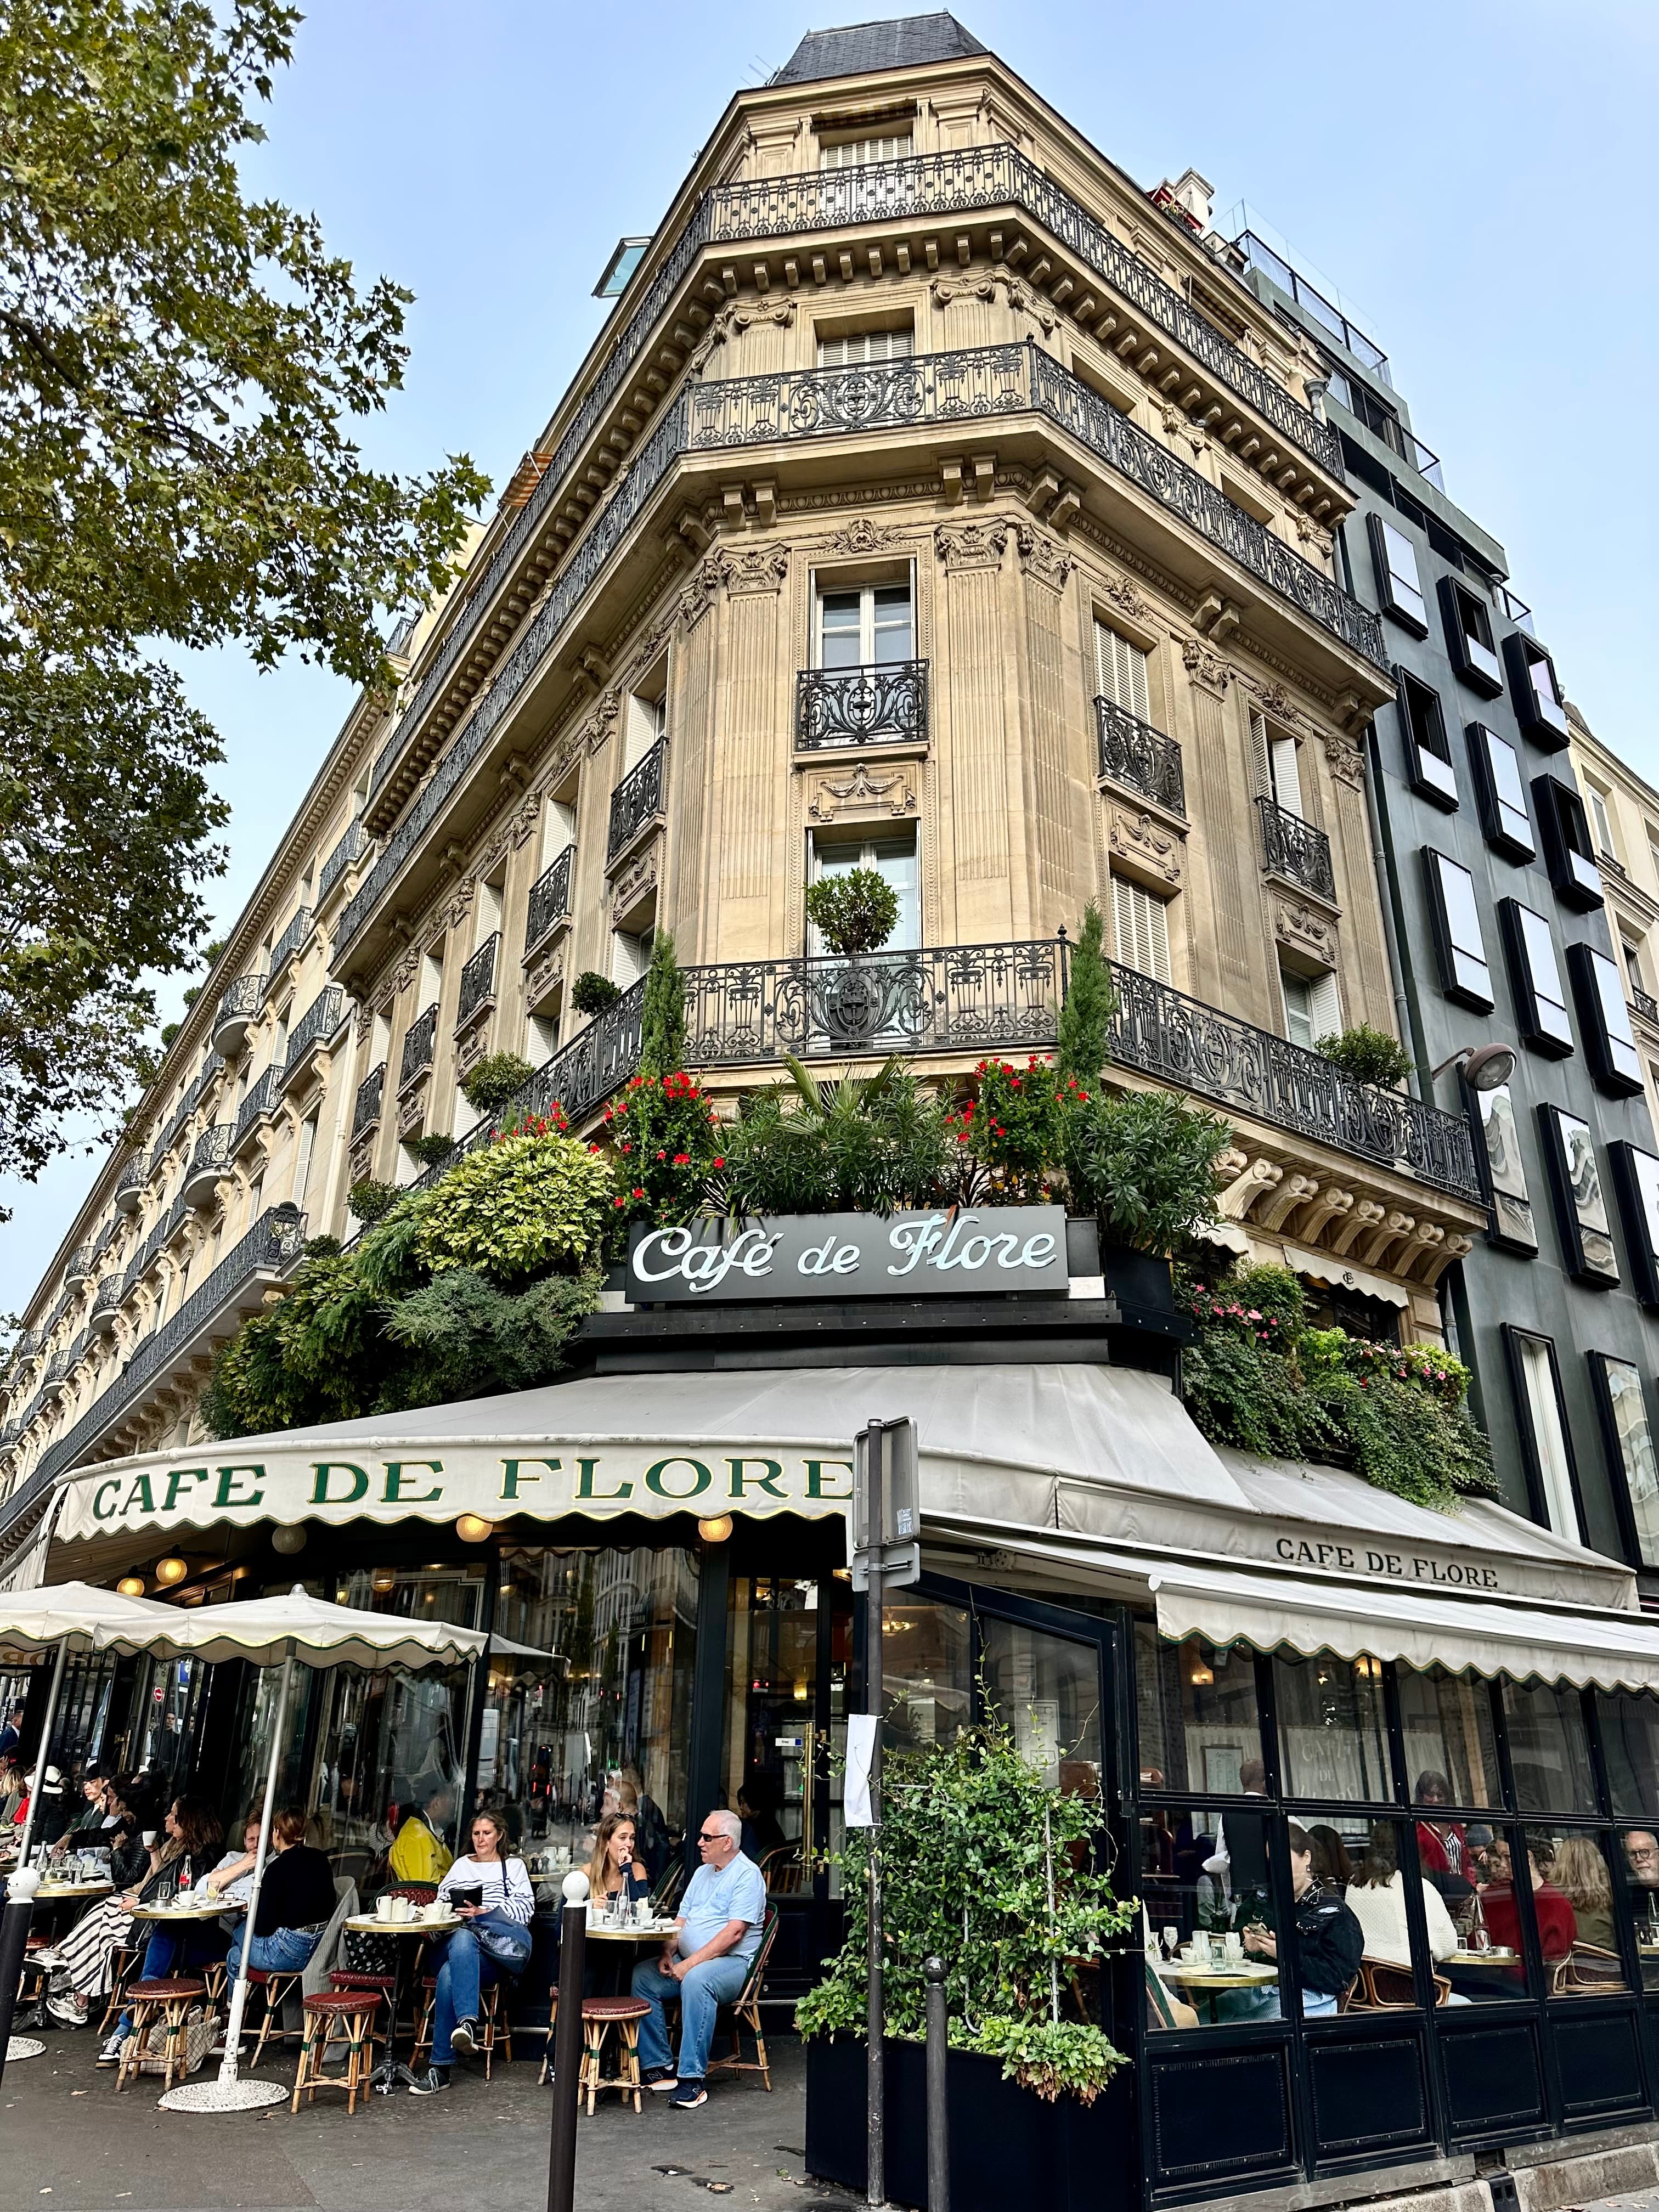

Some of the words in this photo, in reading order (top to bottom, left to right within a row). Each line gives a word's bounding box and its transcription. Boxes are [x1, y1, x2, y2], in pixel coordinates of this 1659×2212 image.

[633, 1227, 784, 1293] Café
[797, 1235, 860, 1274] de
[887, 1213, 1057, 1276] Flore
[92, 1464, 267, 1520] CAFE
[308, 1459, 445, 1505] DE
[496, 1455, 853, 1502] FLORE
[1276, 1538, 1355, 1568] CAFE
[1365, 1551, 1402, 1575] DE
[1413, 1558, 1498, 1588] FLORE
[1319, 1769, 1335, 1782] DE
